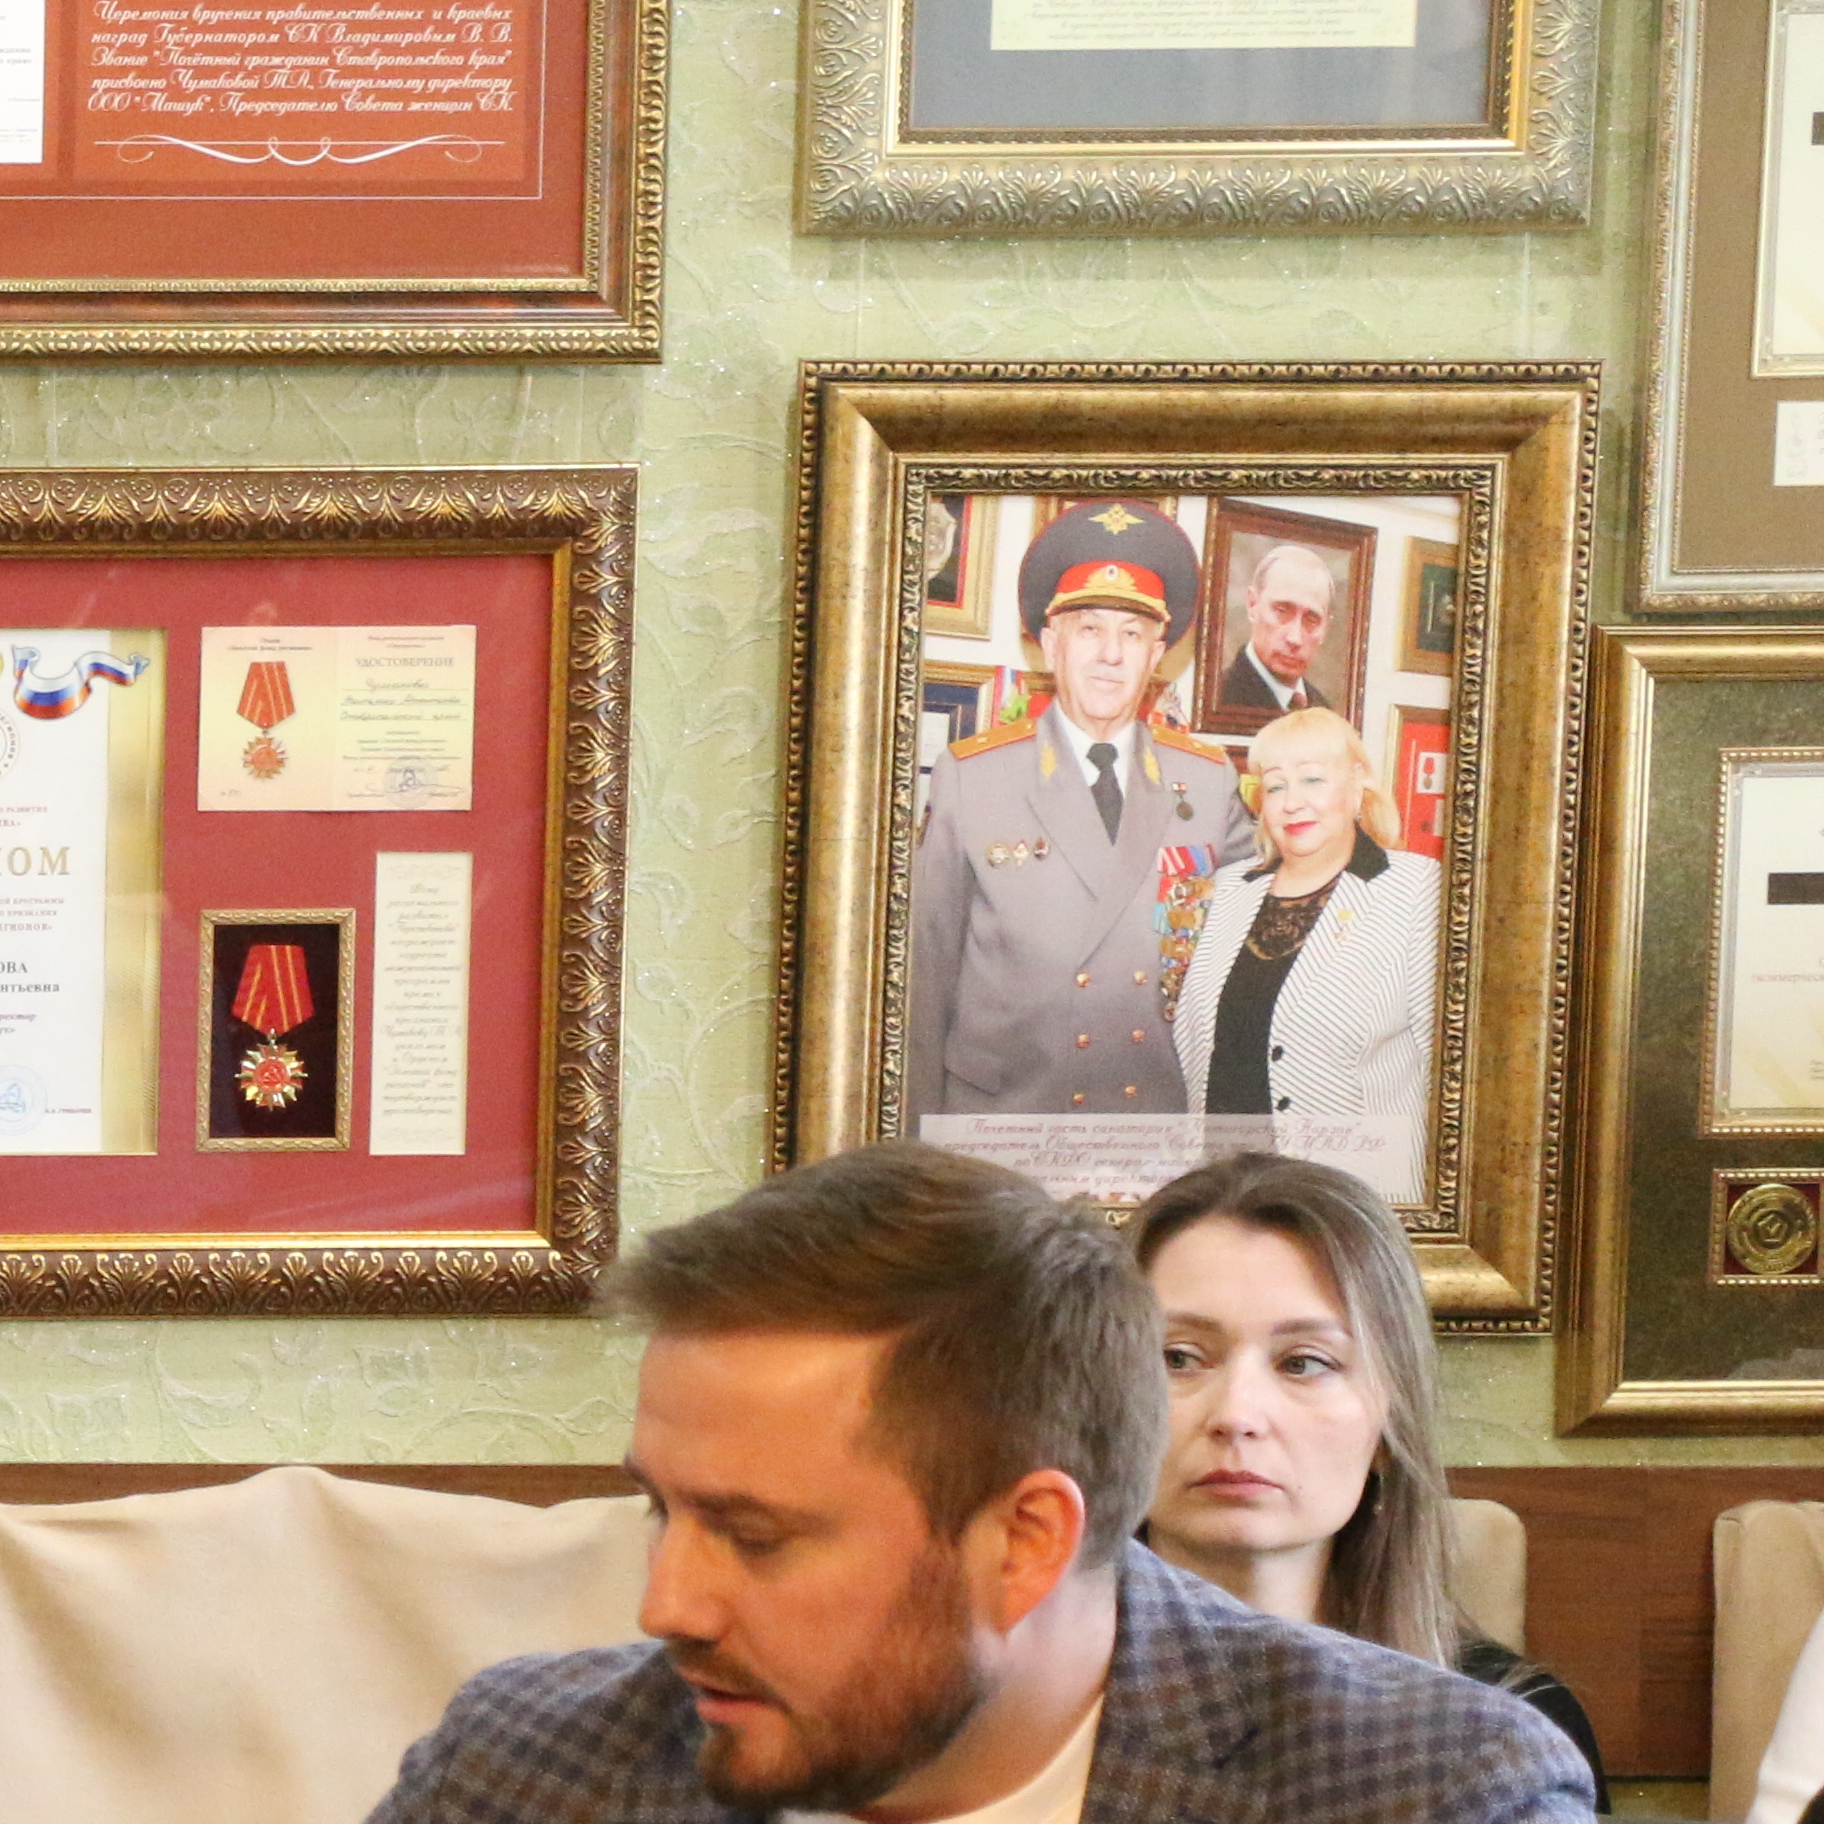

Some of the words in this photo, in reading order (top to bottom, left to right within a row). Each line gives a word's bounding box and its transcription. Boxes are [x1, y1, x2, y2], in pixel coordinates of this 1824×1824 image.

[93, 0, 189, 25] Церемония
[191, 1, 262, 25] вручения
[265, 1, 424, 25] правительственных
[431, 9, 443, 20] и
[447, 1, 514, 25] краевых
[91, 32, 149, 48] наград
[153, 22, 281, 48] Губернатором
[284, 22, 326, 44] СК
[325, 22, 457, 48] Владимировым
[460, 21, 484, 44] В.
[488, 21, 513, 44] В.
[91, 45, 149, 67] Звание
[243, 54, 330, 71] гражданин
[332, 45, 465, 71] Ставропольского
[467, 47, 513, 70] края"
[91, 70, 167, 94] присвоено
[170, 68, 261, 94] Чумаковой
[318, 68, 426, 93] Генеральному
[427, 70, 513, 94] директору
[86, 91, 132, 112] ООО
[219, 91, 339, 117] Председателю
[341, 91, 405, 112] Совета
[407, 101, 473, 115] женщин
[355, 656, 456, 668] УДОСТОВЕРЕНИЕ
